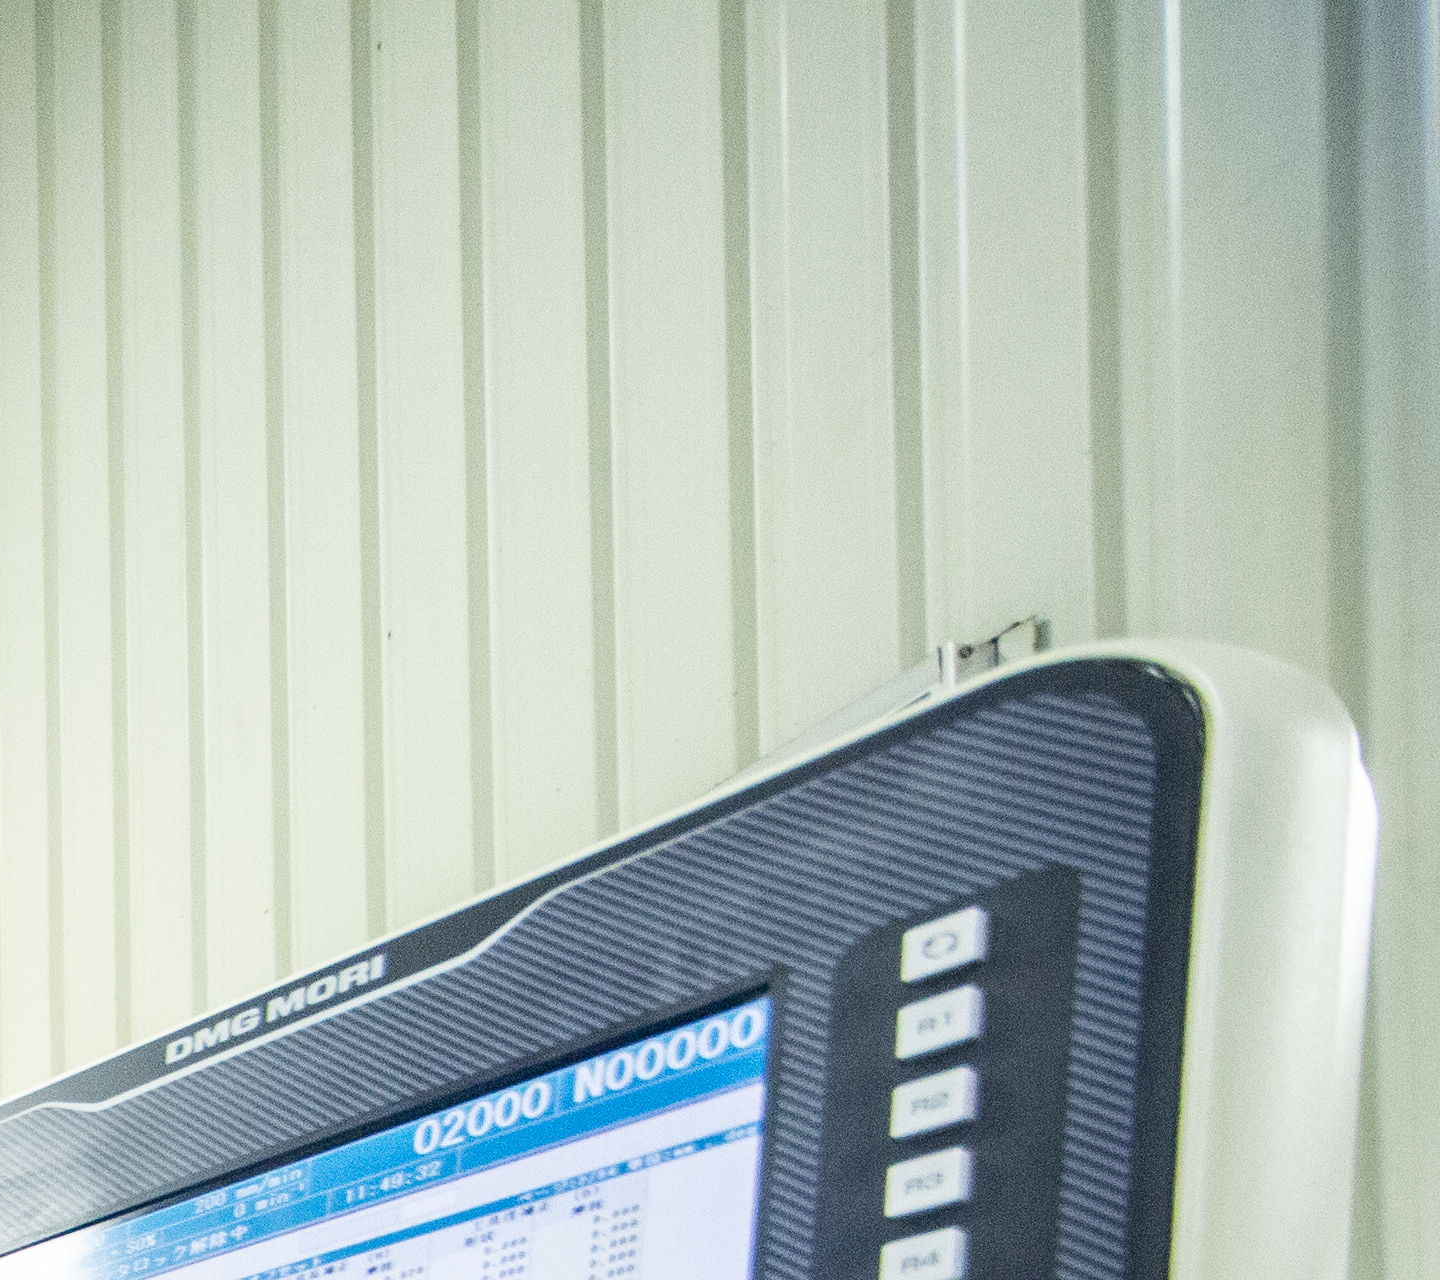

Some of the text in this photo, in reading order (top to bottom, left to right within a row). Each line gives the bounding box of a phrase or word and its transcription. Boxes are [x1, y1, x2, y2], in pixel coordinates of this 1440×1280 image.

[165, 953, 387, 1066] DMG MORI
[917, 1008, 954, 1038] R1
[911, 1089, 952, 1116] R2
[900, 1251, 942, 1275] R4
